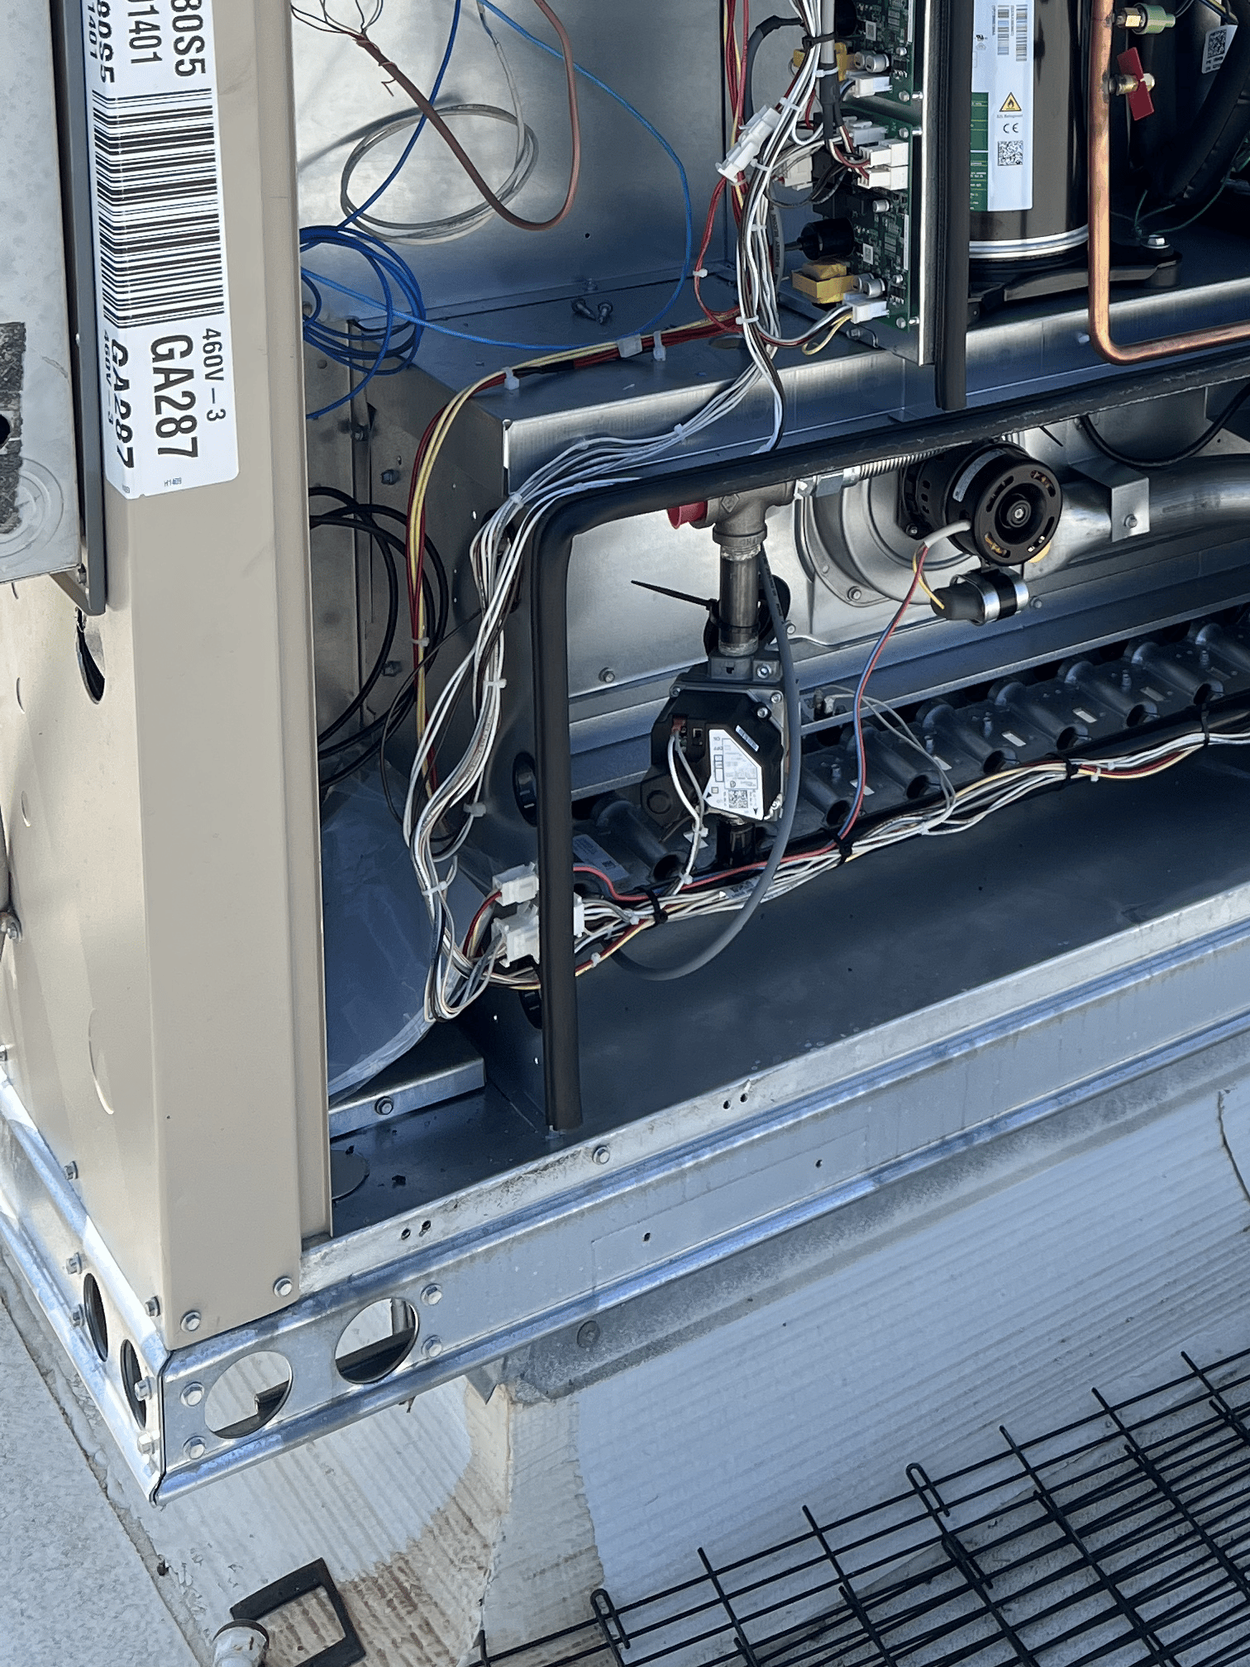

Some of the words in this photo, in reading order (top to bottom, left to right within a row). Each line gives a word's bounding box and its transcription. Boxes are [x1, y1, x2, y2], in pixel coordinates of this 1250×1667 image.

[111, 338, 135, 470] GA287
[150, 334, 199, 459] GA287
[202, 328, 224, 381] 460V
